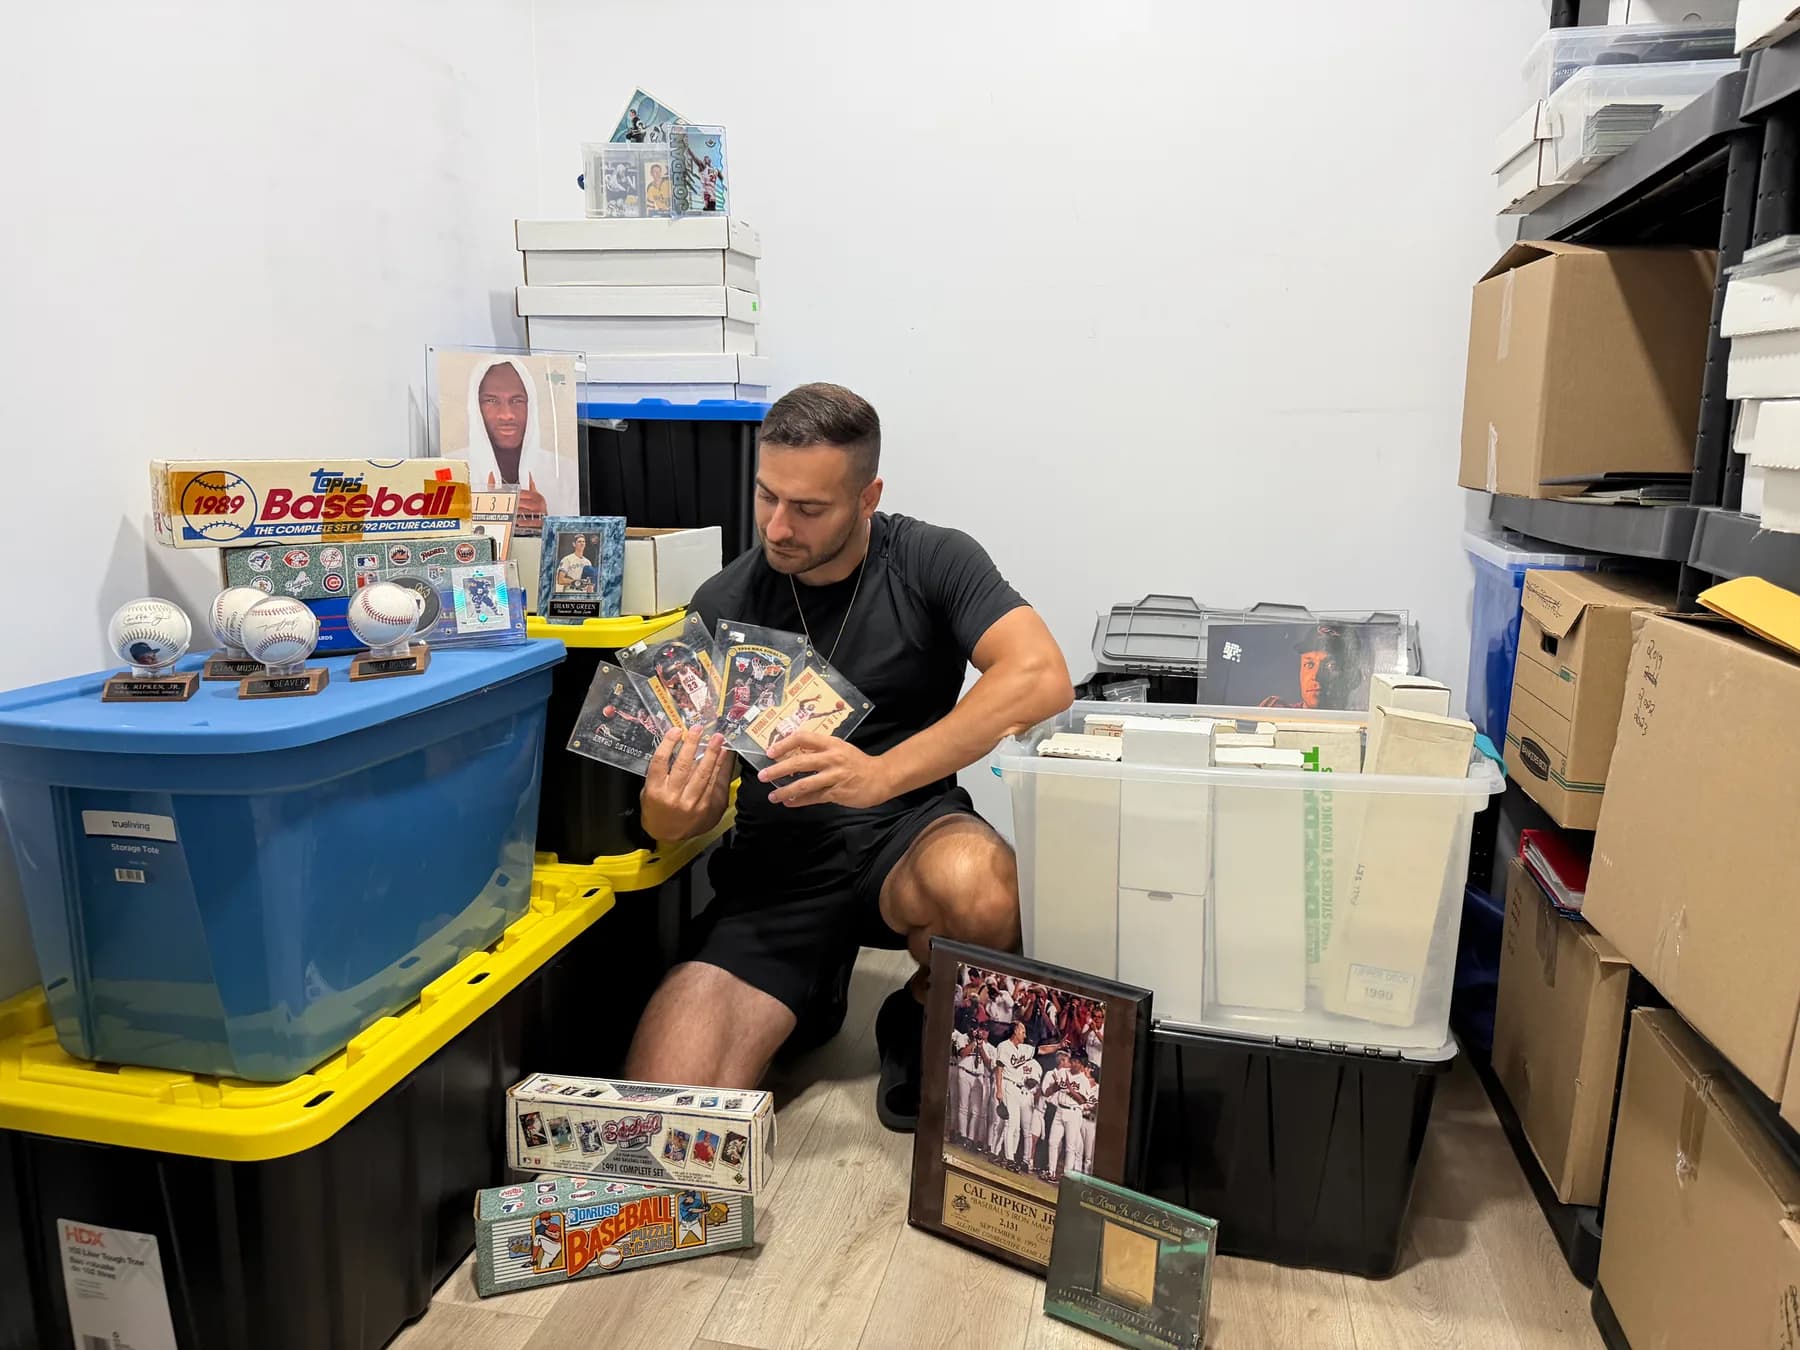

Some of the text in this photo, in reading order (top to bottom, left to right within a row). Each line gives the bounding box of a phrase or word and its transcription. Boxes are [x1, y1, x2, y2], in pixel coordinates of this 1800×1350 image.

[669, 134, 689, 211] JORDAN
[193, 495, 245, 515] 1989
[260, 486, 455, 520] Baseball
[254, 520, 456, 535] THE COMPLETE SET 792 PICTURE CARDS
[236, 663, 262, 672] MUSIAL
[274, 679, 306, 688] SEAVER
[687, 682, 697, 692] 23
[112, 820, 150, 831] trueliving
[1322, 806, 1333, 853] TRADING
[112, 844, 160, 854] Storage Tote
[1322, 867, 1333, 919] STICKERS
[1364, 987, 1393, 1001] 1990
[602, 1163, 618, 1173] 1991
[619, 1164, 651, 1176] COMPLETE
[652, 1168, 664, 1177] SET
[964, 1183, 986, 1200] CAL
[991, 1192, 1037, 1218] RIPKEN
[570, 1204, 619, 1224] DONRUSS
[1012, 1213, 1030, 1224] IRON
[65, 1225, 105, 1247] HDX
[568, 1195, 674, 1276] BASEBALL
[630, 1225, 673, 1242] PUZZLE
[980, 1222, 1015, 1240] SEPTEMBER
[634, 1238, 673, 1255] CARDS
